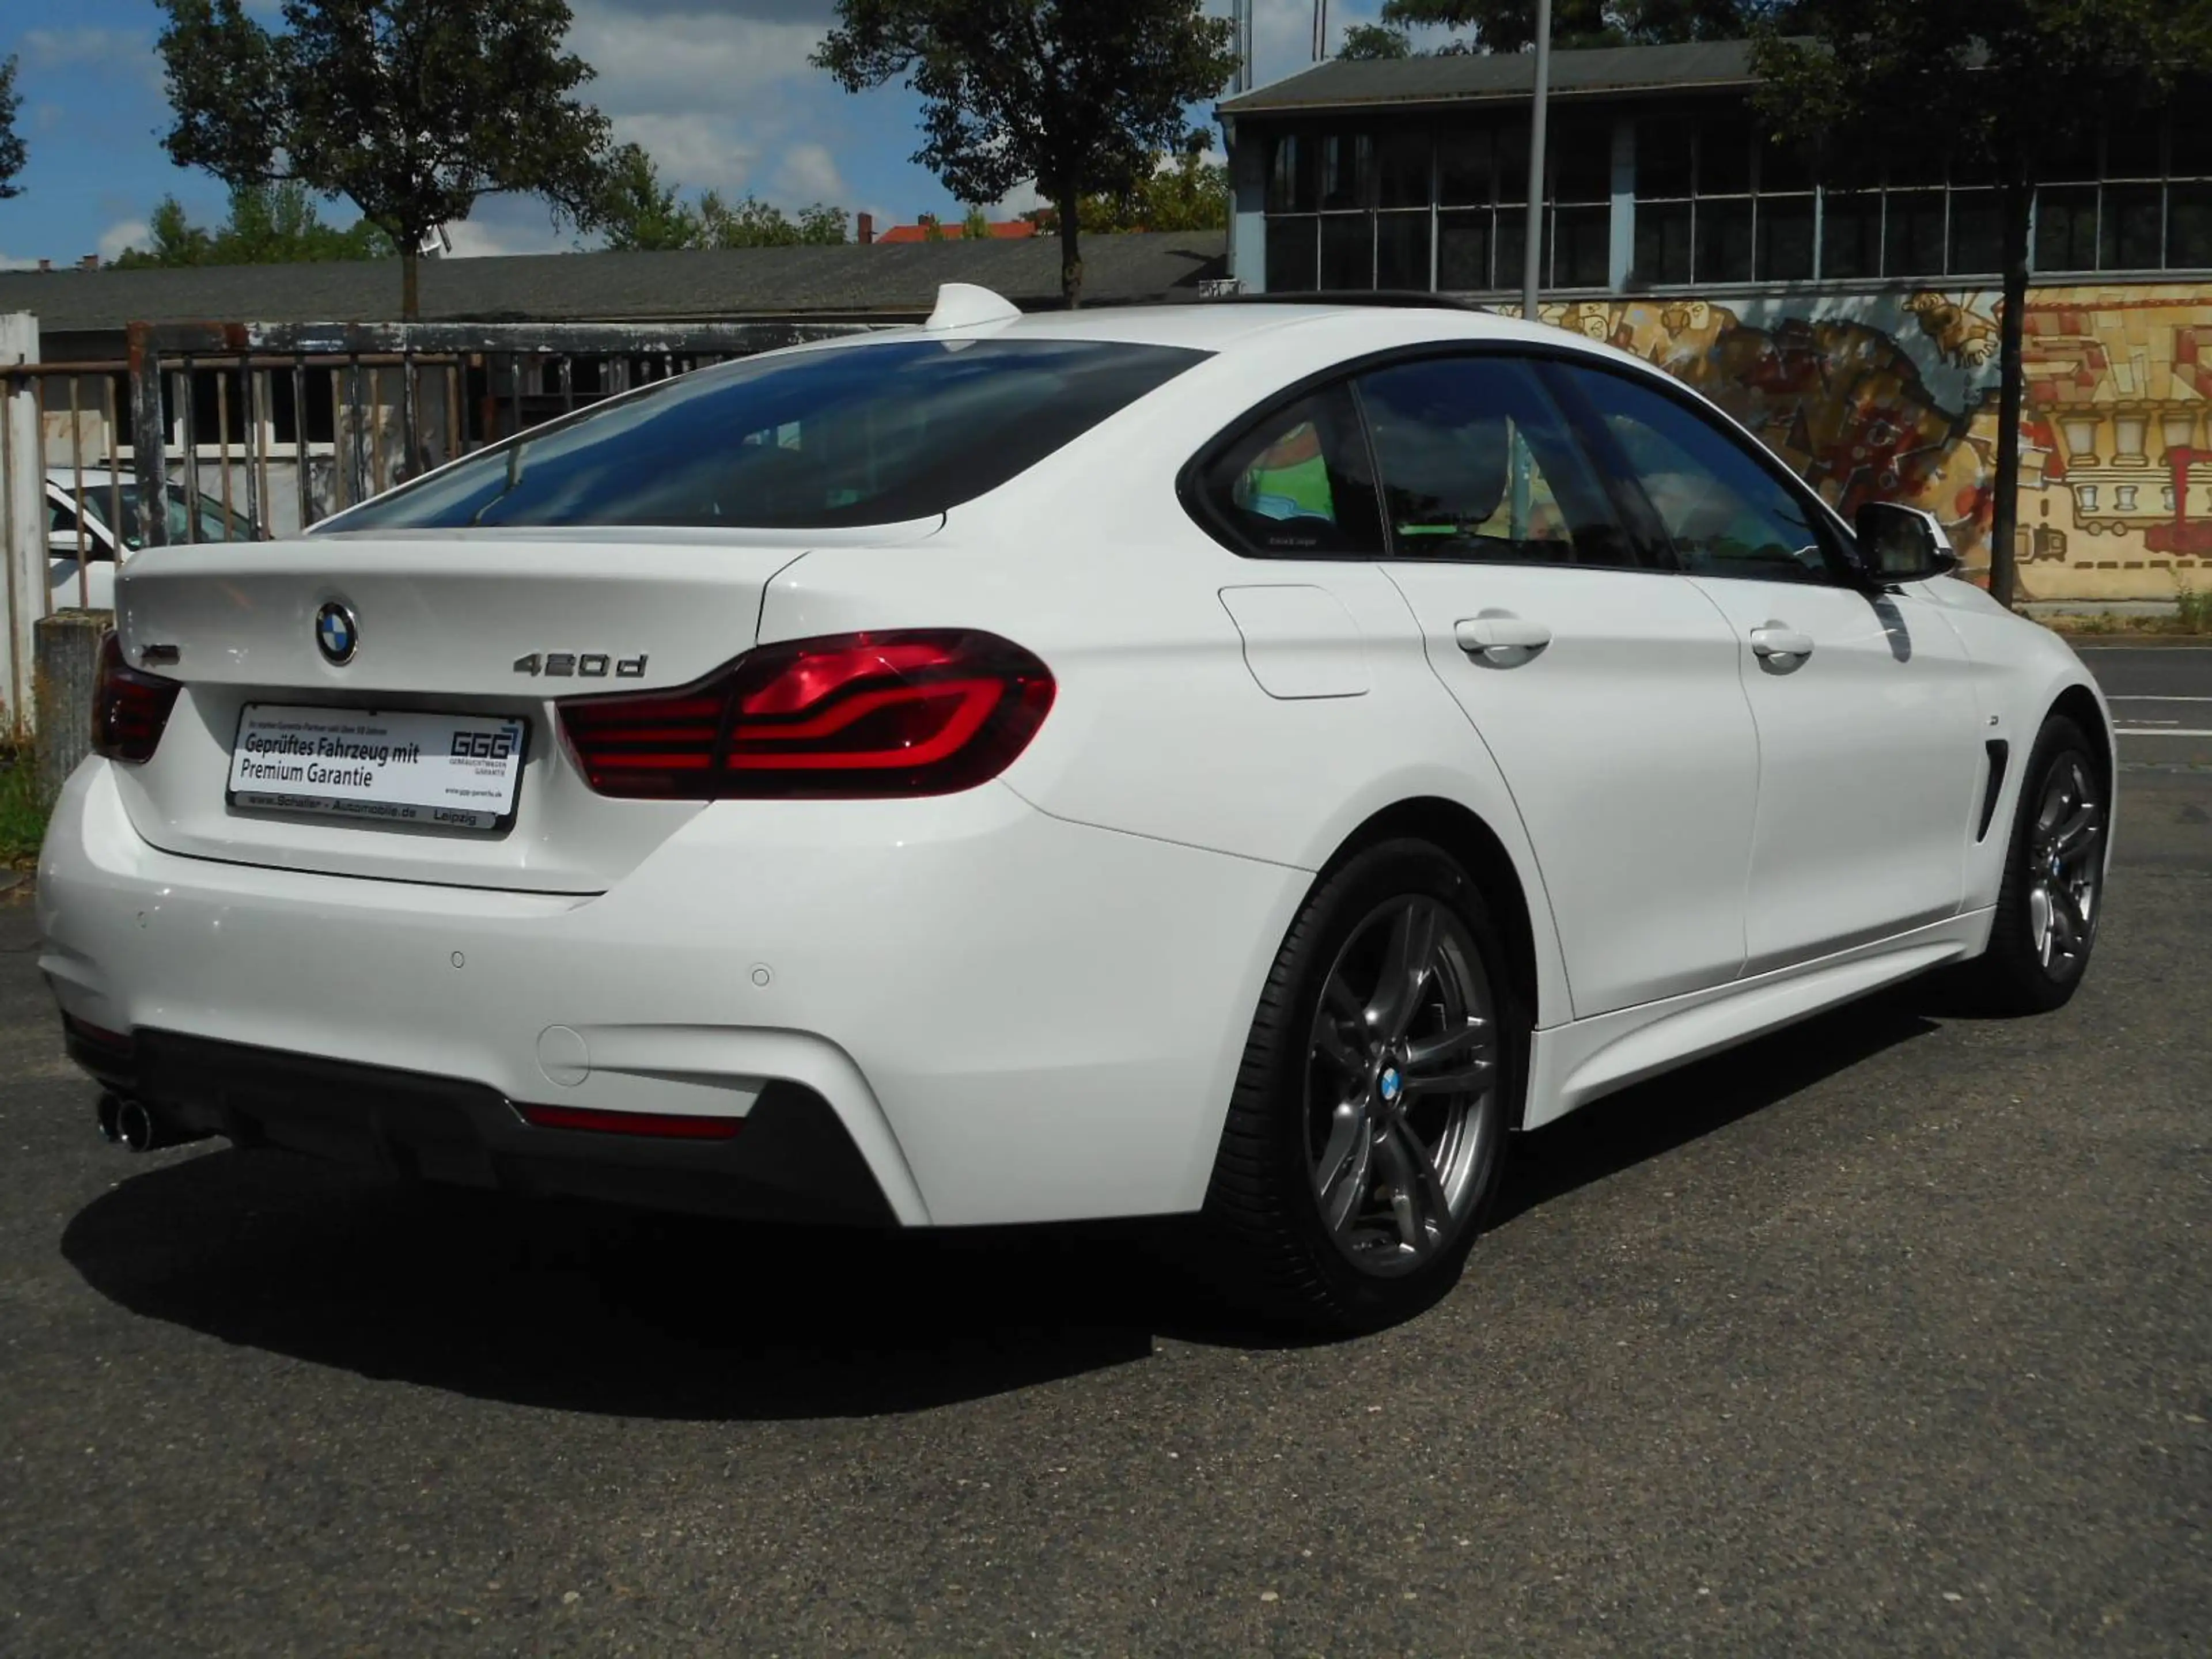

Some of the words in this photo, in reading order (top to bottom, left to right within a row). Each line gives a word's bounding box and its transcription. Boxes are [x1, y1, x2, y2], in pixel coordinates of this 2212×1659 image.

[513, 653, 649, 678] 420d
[245, 733, 314, 757] Geprüftes
[317, 737, 388, 766] Fahrzeug
[392, 743, 421, 764] mit
[450, 731, 513, 759] GGG
[241, 758, 303, 782] Premium
[307, 763, 373, 787] Garantie
[434, 809, 478, 825] Leipzig
